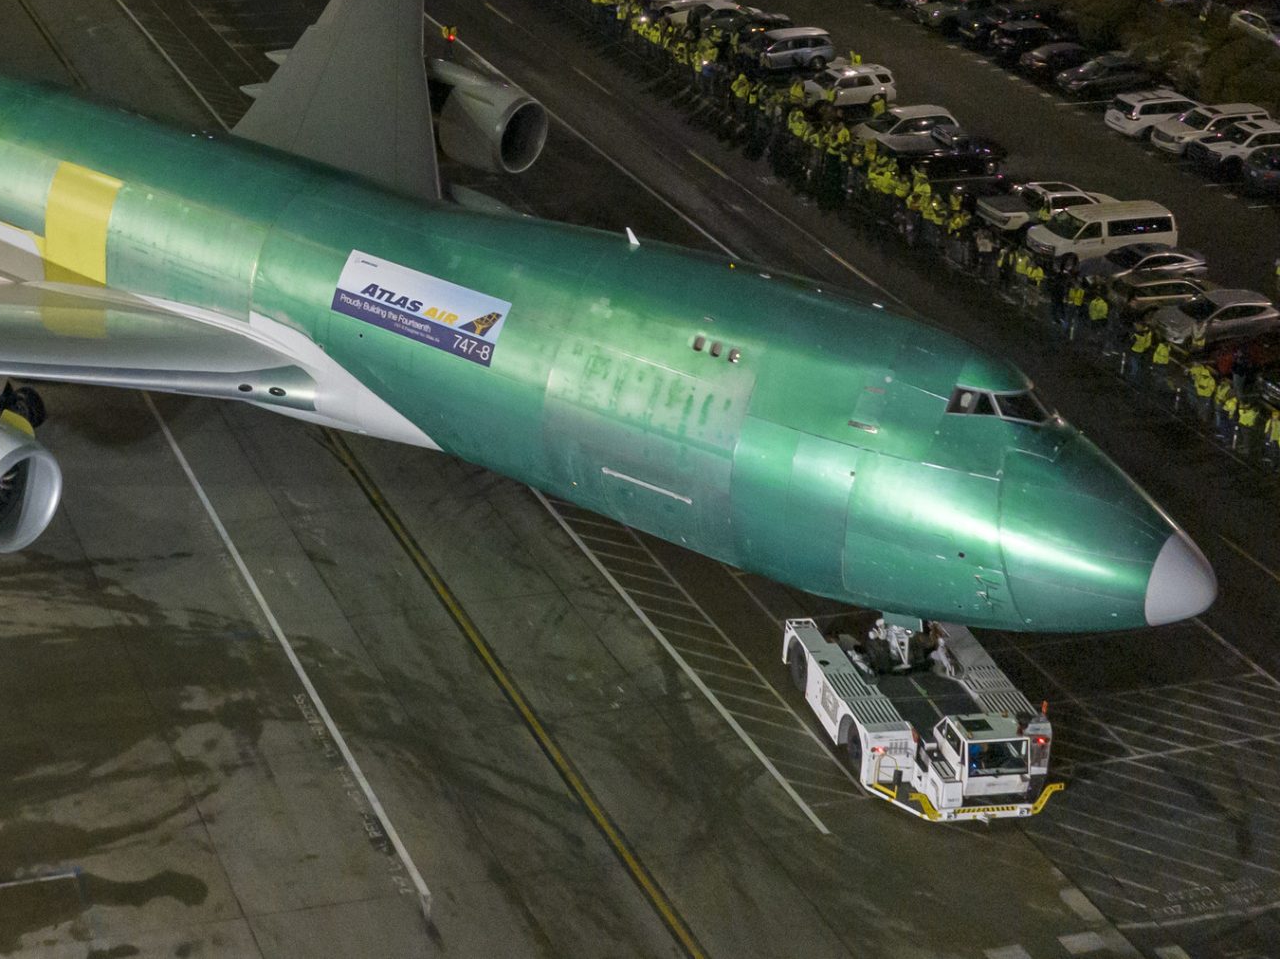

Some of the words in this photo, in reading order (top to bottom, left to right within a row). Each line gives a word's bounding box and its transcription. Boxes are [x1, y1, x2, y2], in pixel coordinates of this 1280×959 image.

[340, 293, 363, 310] Proudly
[363, 301, 387, 318] Building
[387, 310, 398, 321] the
[361, 283, 423, 312] ATLAS
[423, 307, 459, 326] AIR
[453, 333, 490, 361] 747-8
